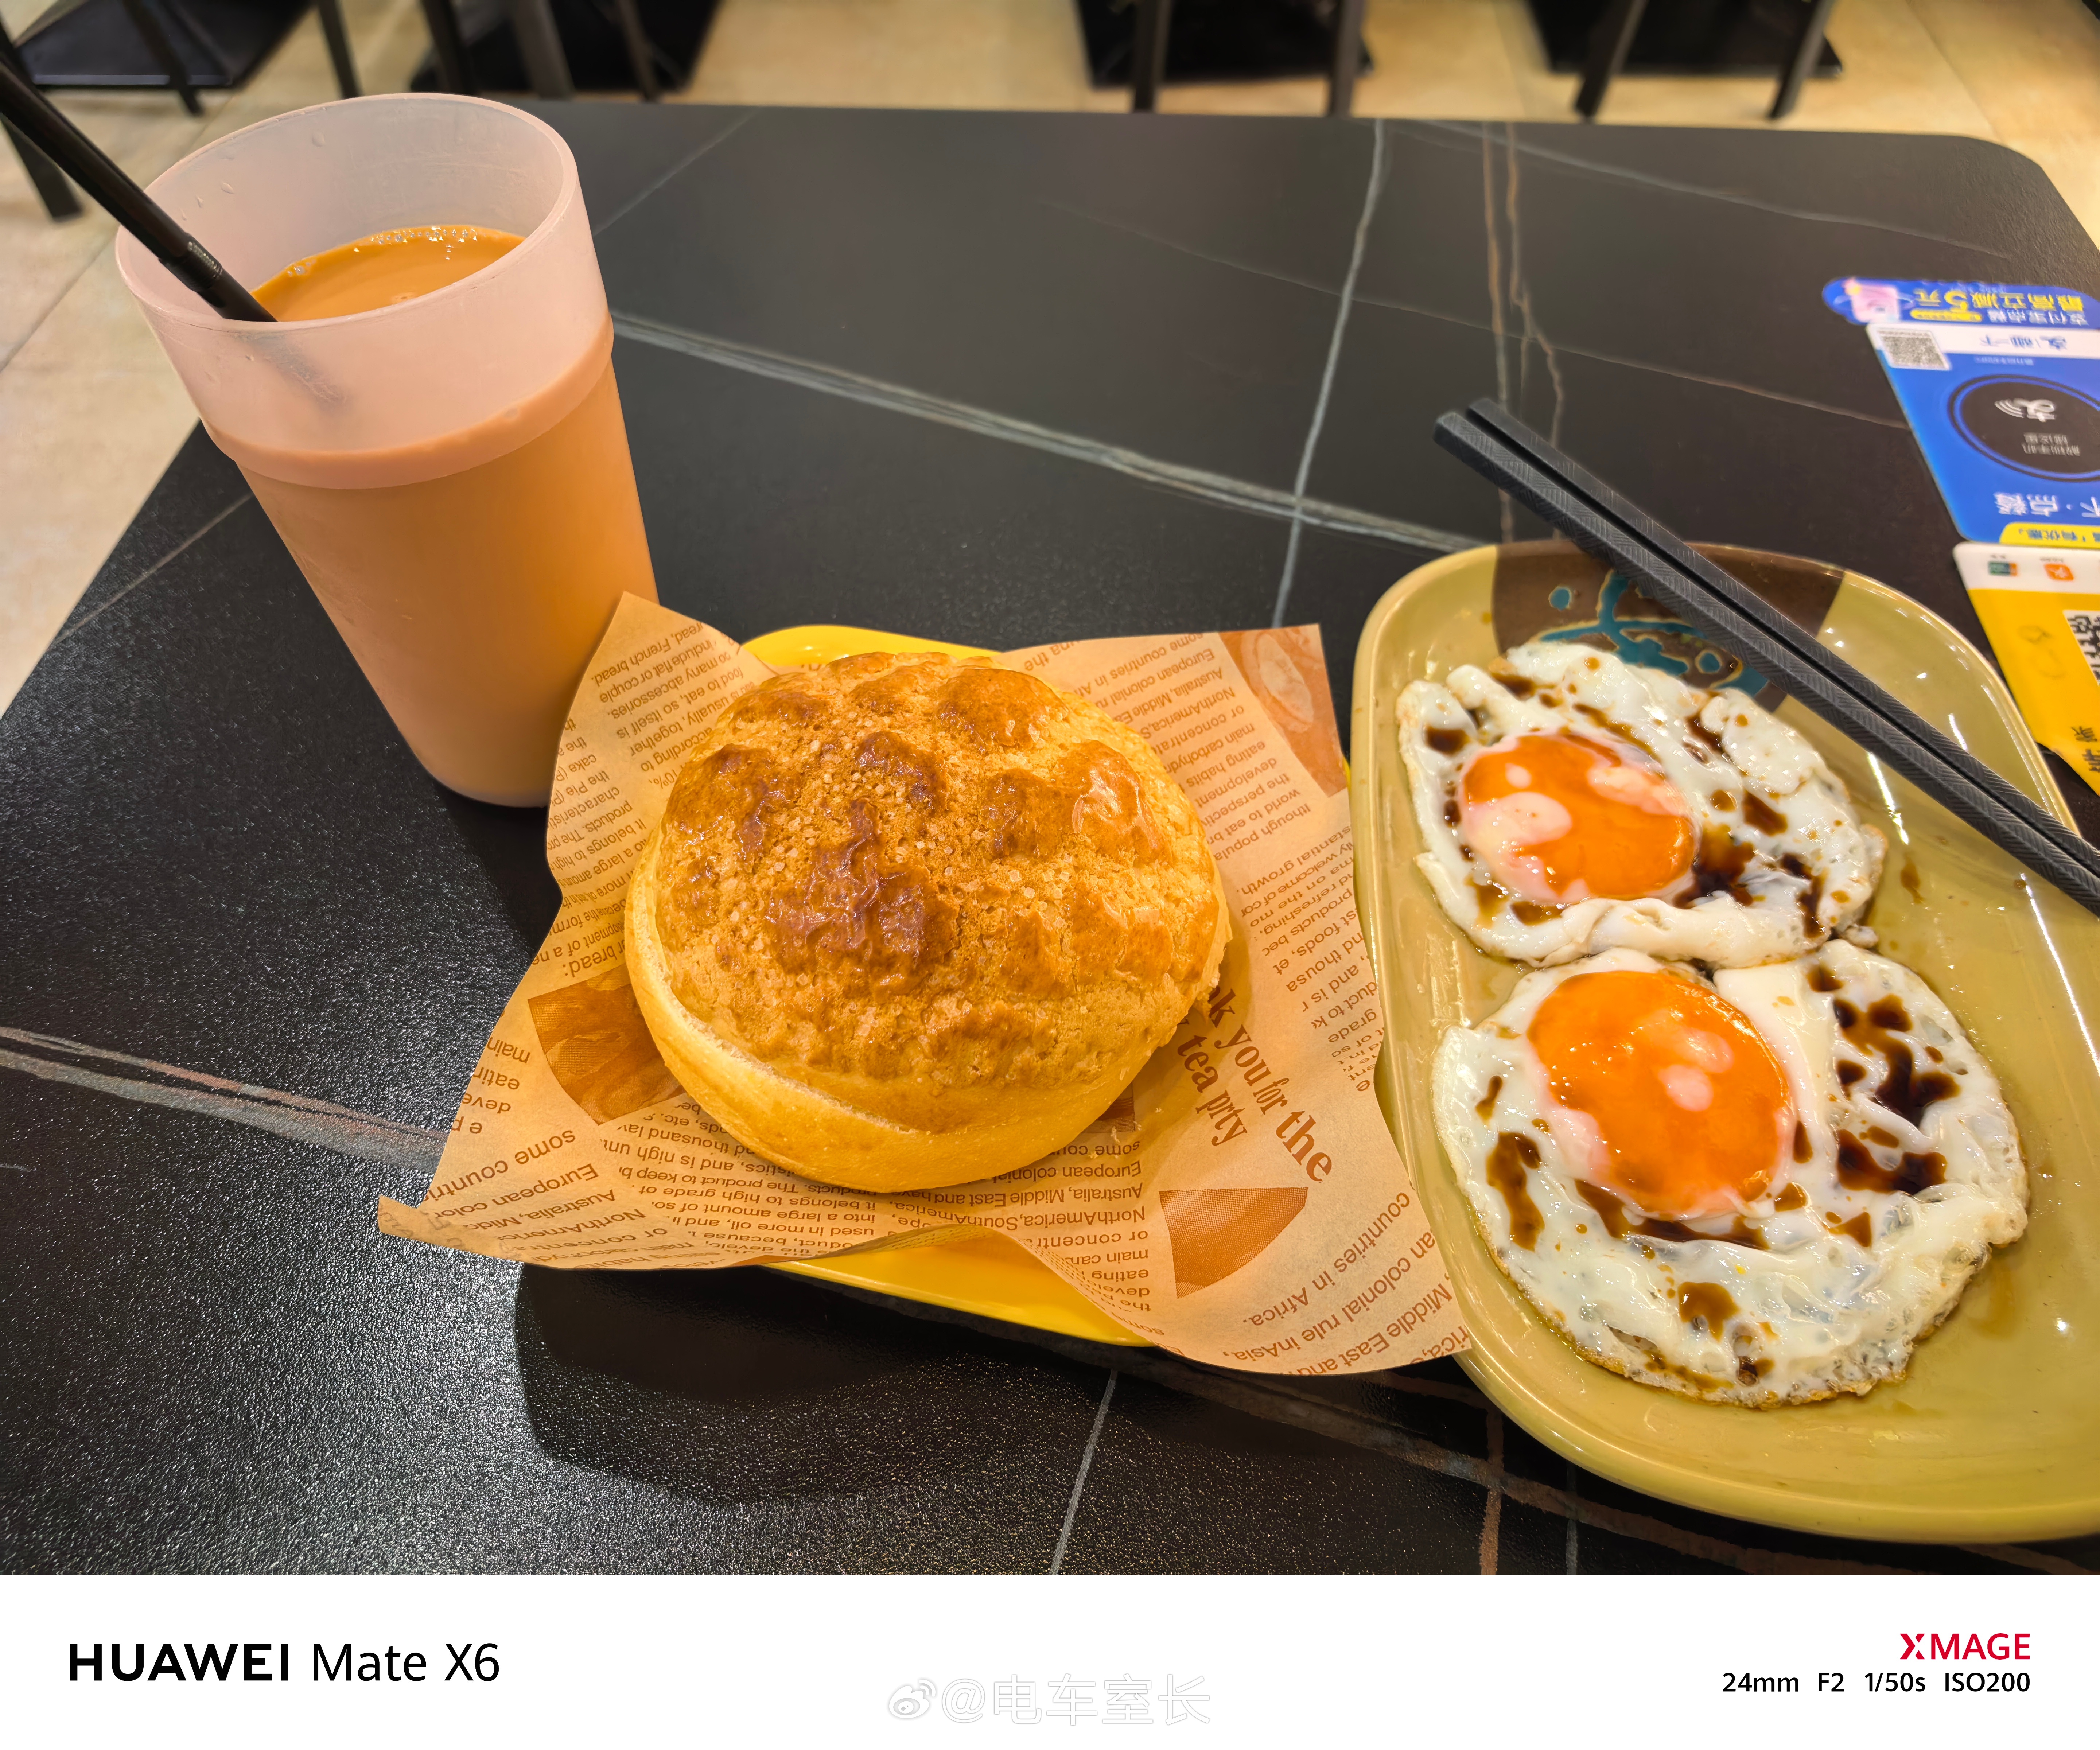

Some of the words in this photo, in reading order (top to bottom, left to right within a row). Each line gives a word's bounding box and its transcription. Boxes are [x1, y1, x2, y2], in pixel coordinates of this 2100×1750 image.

[1913, 288, 2084, 313] 最高立减5元
[629, 638, 672, 666] French
[685, 657, 719, 682] many
[1109, 646, 1167, 680] countries
[1156, 648, 1216, 681] European
[591, 660, 630, 688] bread.
[640, 669, 653, 684] or
[720, 666, 744, 687] food
[1094, 674, 1109, 687] in
[1169, 666, 1223, 697] Australia,
[599, 676, 640, 703] couple
[707, 678, 721, 692] to
[1109, 675, 1156, 706] colonial
[679, 687, 705, 705] eat,
[1132, 692, 1173, 717] Middle
[662, 700, 680, 715] so
[681, 696, 731, 726] usually,
[1230, 705, 1245, 719] or
[564, 718, 576, 732] th
[630, 709, 664, 736] itself
[615, 726, 631, 739] is
[629, 721, 684, 757] together
[1224, 723, 1256, 744] main
[565, 736, 587, 752] the
[1163, 738, 1224, 774] carbohydr
[1225, 740, 1266, 767] eating
[568, 754, 597, 773] cake
[640, 760, 655, 772] to
[587, 770, 610, 785] the
[1185, 762, 1227, 788] habits
[1194, 757, 1278, 809] development
[1266, 773, 1290, 789] the
[565, 781, 589, 796] Pie
[548, 786, 620, 830] characteristi
[1263, 789, 1301, 815] world
[582, 800, 633, 833] products.
[1248, 809, 1263, 821] to
[1224, 818, 1247, 836] eat
[560, 829, 585, 844] The
[586, 824, 637, 855] belongs
[573, 849, 588, 861] to
[622, 848, 634, 858] a
[592, 853, 625, 875] large
[1236, 859, 1295, 895] growth.
[1277, 853, 1342, 894] welcome
[596, 875, 627, 897] more
[1306, 875, 1326, 891] on
[1263, 891, 1277, 907] of
[1278, 891, 1303, 909] the
[1254, 883, 1342, 936] refreshing,
[1286, 888, 1359, 936] products
[549, 914, 584, 936] form
[567, 940, 581, 957] of
[1291, 922, 1340, 957] foods,
[552, 946, 563, 958] a
[562, 945, 618, 979] bread:
[1327, 964, 1360, 994] and
[1311, 988, 1329, 1003] is
[1327, 1004, 1345, 1019] to
[1327, 1008, 1377, 1043] grade
[486, 1035, 531, 1064] main
[1356, 1035, 1372, 1048] of
[1177, 1035, 1218, 1094] tea
[472, 1063, 520, 1090] eati
[1213, 1024, 1272, 1087] you
[1252, 1077, 1290, 1116] for
[1275, 1110, 1333, 1182] the
[660, 1113, 690, 1127] etc.
[1195, 1090, 1248, 1147] prty
[514, 1129, 576, 1165] some
[647, 1128, 730, 1155] thousand
[1094, 1140, 1141, 1156] some
[680, 1155, 696, 1169] is
[699, 1158, 735, 1171] and
[1062, 1160, 1142, 1178] European
[420, 1160, 509, 1202] countri
[491, 1163, 599, 1206] European
[636, 1167, 678, 1184] keep
[681, 1175, 697, 1185] to
[700, 1176, 763, 1188] product
[662, 1187, 716, 1198] grade
[722, 1190, 761, 1204] high
[766, 1182, 799, 1194] The
[1068, 1182, 1143, 1203] Australia,
[518, 1189, 616, 1220] Australia,
[766, 1196, 783, 1206] to
[789, 1191, 860, 1217] belongs
[865, 1201, 877, 1212] it
[934, 1193, 966, 1205] and
[968, 1193, 1007, 1208] East
[1010, 1189, 1065, 1206] Middle
[678, 1203, 699, 1213] of
[702, 1203, 772, 1217] amount
[776, 1210, 821, 1223] large
[493, 1208, 647, 1241] NorthAmeric
[684, 1217, 720, 1227] and
[726, 1218, 752, 1231] oil,
[843, 1213, 876, 1224] into
[644, 1228, 668, 1238] or
[757, 1223, 805, 1233] more
[808, 1226, 825, 1237] in
[829, 1227, 875, 1243] used
[1128, 1230, 1148, 1241] or
[1333, 1192, 1411, 1273] countries
[703, 1232, 787, 1250] because
[1025, 1233, 1122, 1250] concentr
[1106, 1249, 1149, 1264] main
[1091, 1269, 1149, 1283] eating
[1311, 1270, 1336, 1291] in
[1341, 1257, 1411, 1323] colonial
[1242, 1287, 1309, 1326] Africa.
[1386, 1282, 1453, 1338] Middle
[1301, 1314, 1341, 1342] rule
[1222, 1336, 1302, 1361] inAsia,
[1338, 1331, 1391, 1368] East
